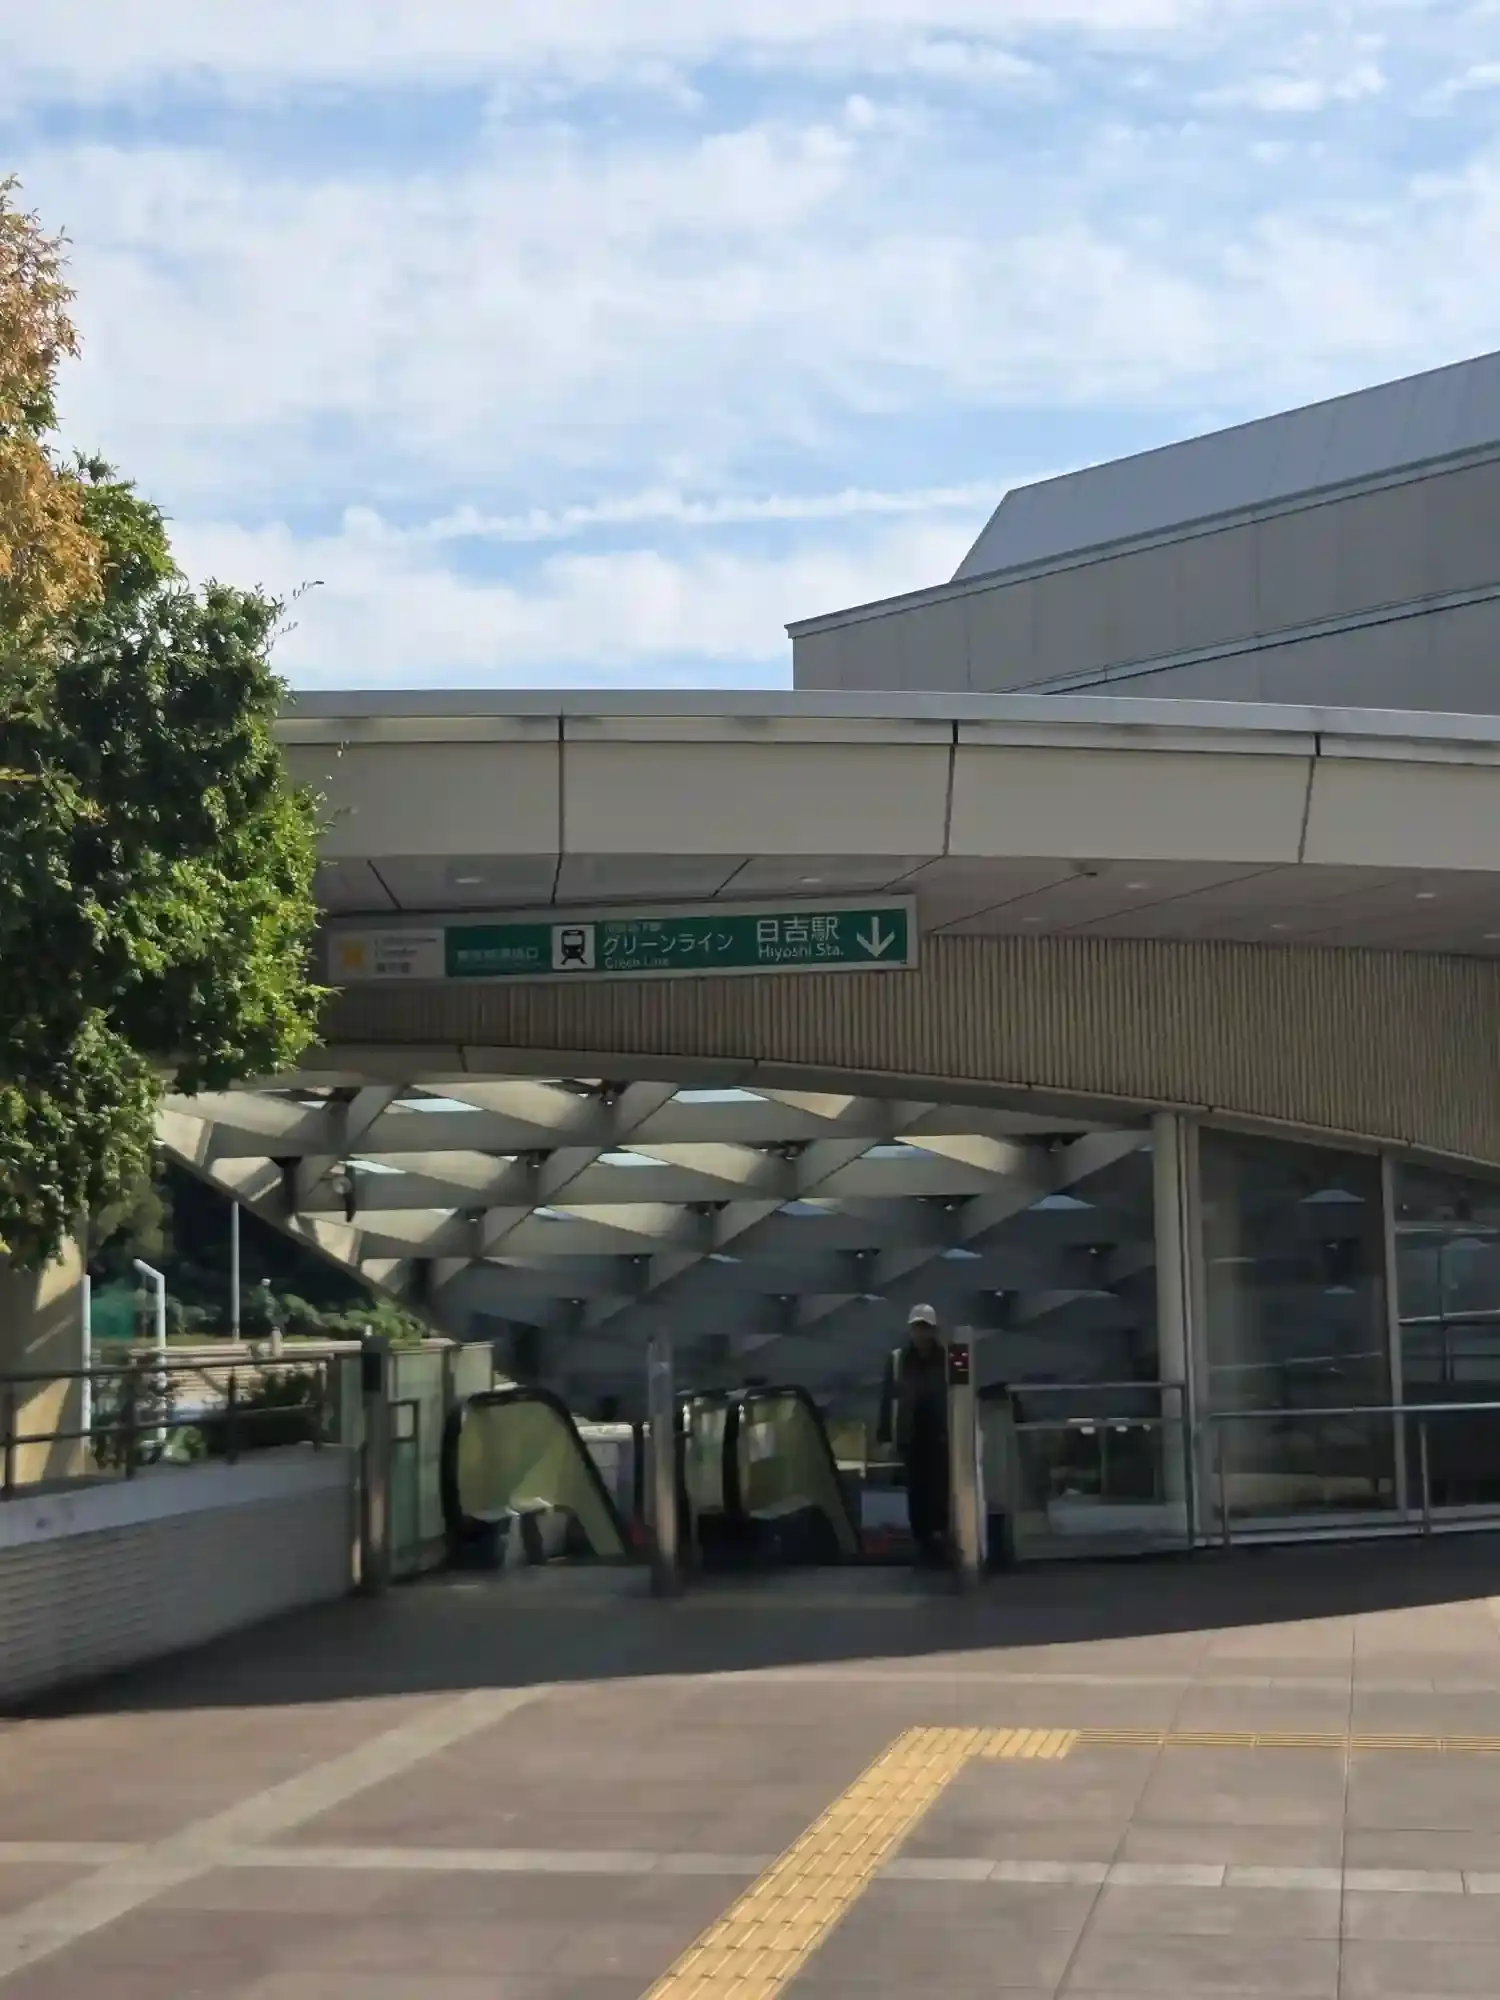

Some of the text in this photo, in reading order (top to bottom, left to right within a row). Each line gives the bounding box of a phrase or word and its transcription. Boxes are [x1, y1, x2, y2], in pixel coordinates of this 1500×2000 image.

[756, 915, 840, 943] 日吉駅
[603, 931, 734, 956] グリーンライン
[758, 942, 844, 962] Hiyoshi Sta.
